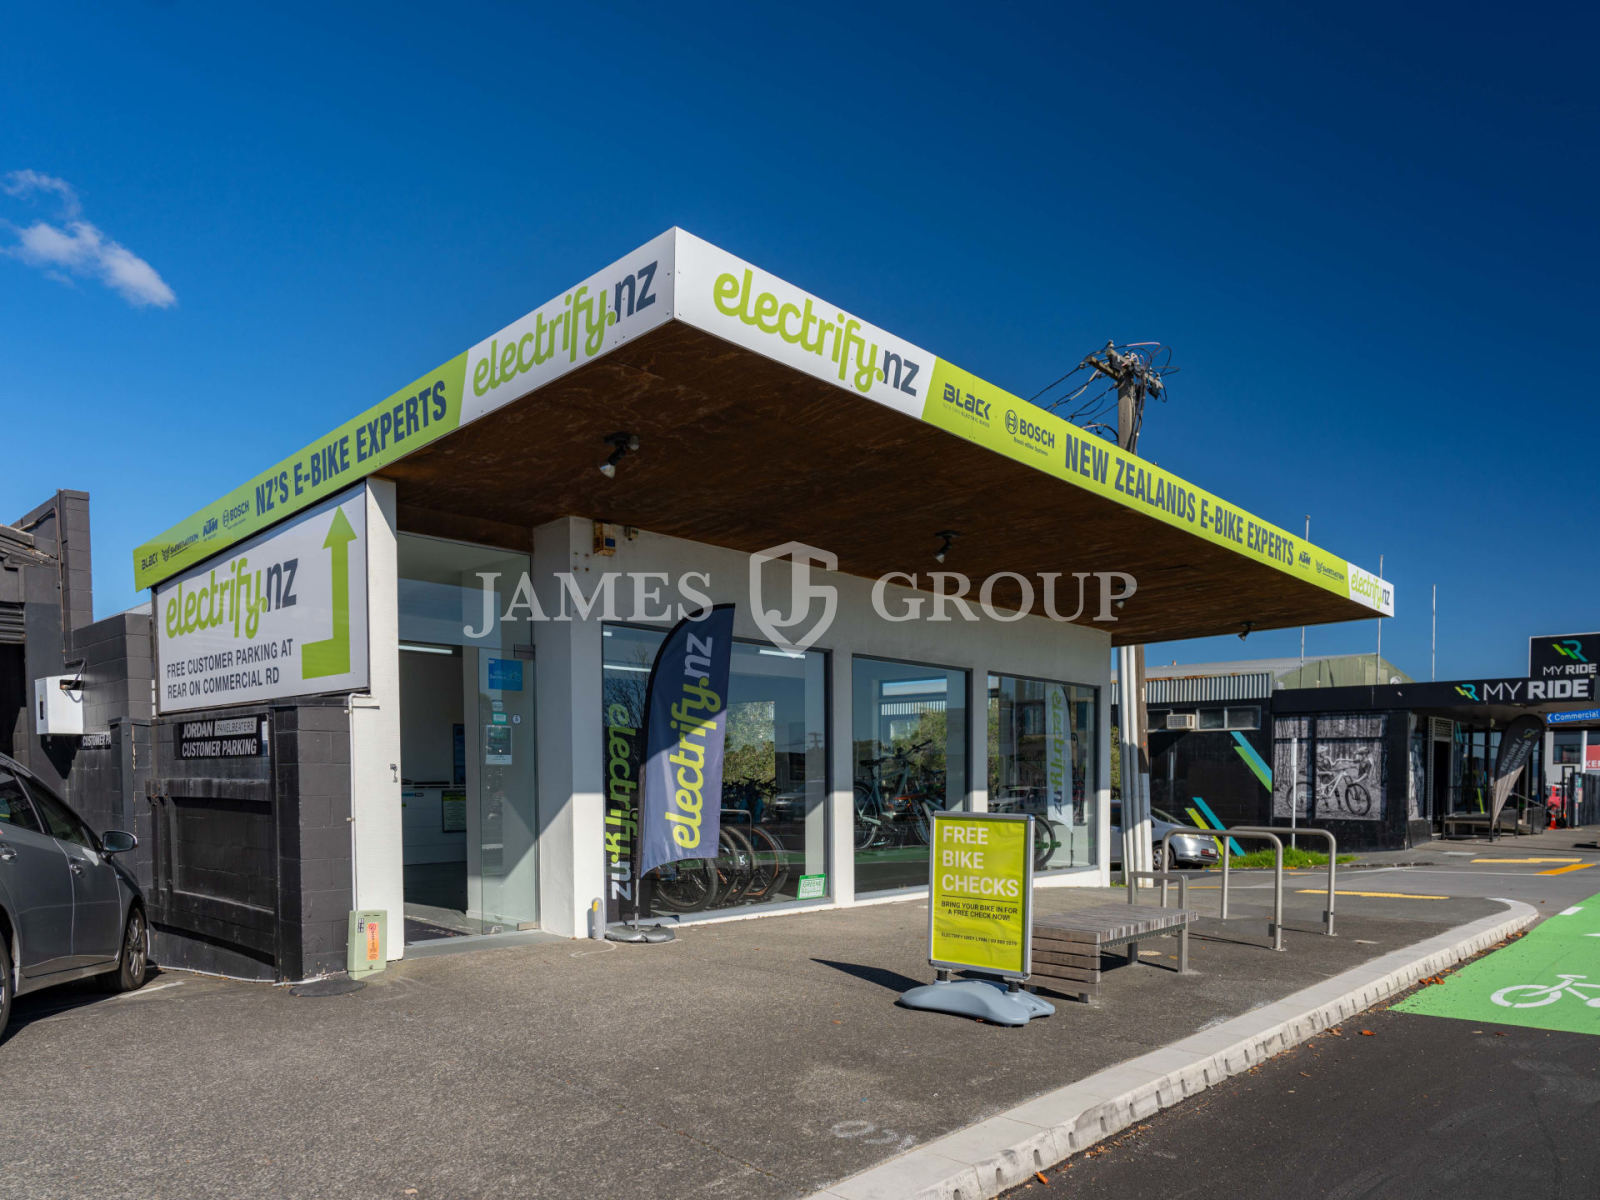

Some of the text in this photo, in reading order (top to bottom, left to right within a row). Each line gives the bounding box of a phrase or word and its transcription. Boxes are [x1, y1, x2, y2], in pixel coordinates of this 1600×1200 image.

[473, 260, 658, 398] electrify.nz
[713, 267, 920, 397] electrify.nz
[1020, 419, 1054, 448] BOSCH
[255, 380, 447, 518] NZ'S E-BIKE EXPERTS
[1065, 433, 1294, 566] NEW ZEALANDS E-BIKE EXPERTS
[229, 500, 250, 521] BOSCH
[202, 517, 218, 537] KTM
[166, 557, 299, 639] electrify.nz
[167, 638, 294, 680] FREE CUSTOMER PARKING AT
[1543, 663, 1597, 676] MY RIDE
[167, 666, 280, 700] REAR ON COMMERCIAL RD
[1483, 679, 1589, 700] MY RIDE
[1554, 710, 1600, 722] Commercial
[182, 720, 214, 739] JORDAN
[182, 738, 257, 758] CUSTOMER PARKING
[665, 632, 721, 849] electrify.nz
[943, 826, 989, 845] FREE
[942, 850, 985, 869] BIKE
[942, 874, 1019, 897] CHECKS
[941, 900, 960, 908] BRING
[962, 902, 978, 910] YOUR
[980, 904, 995, 912] BIKE
[954, 909, 969, 917] FREE
[970, 911, 991, 919] CHECK
